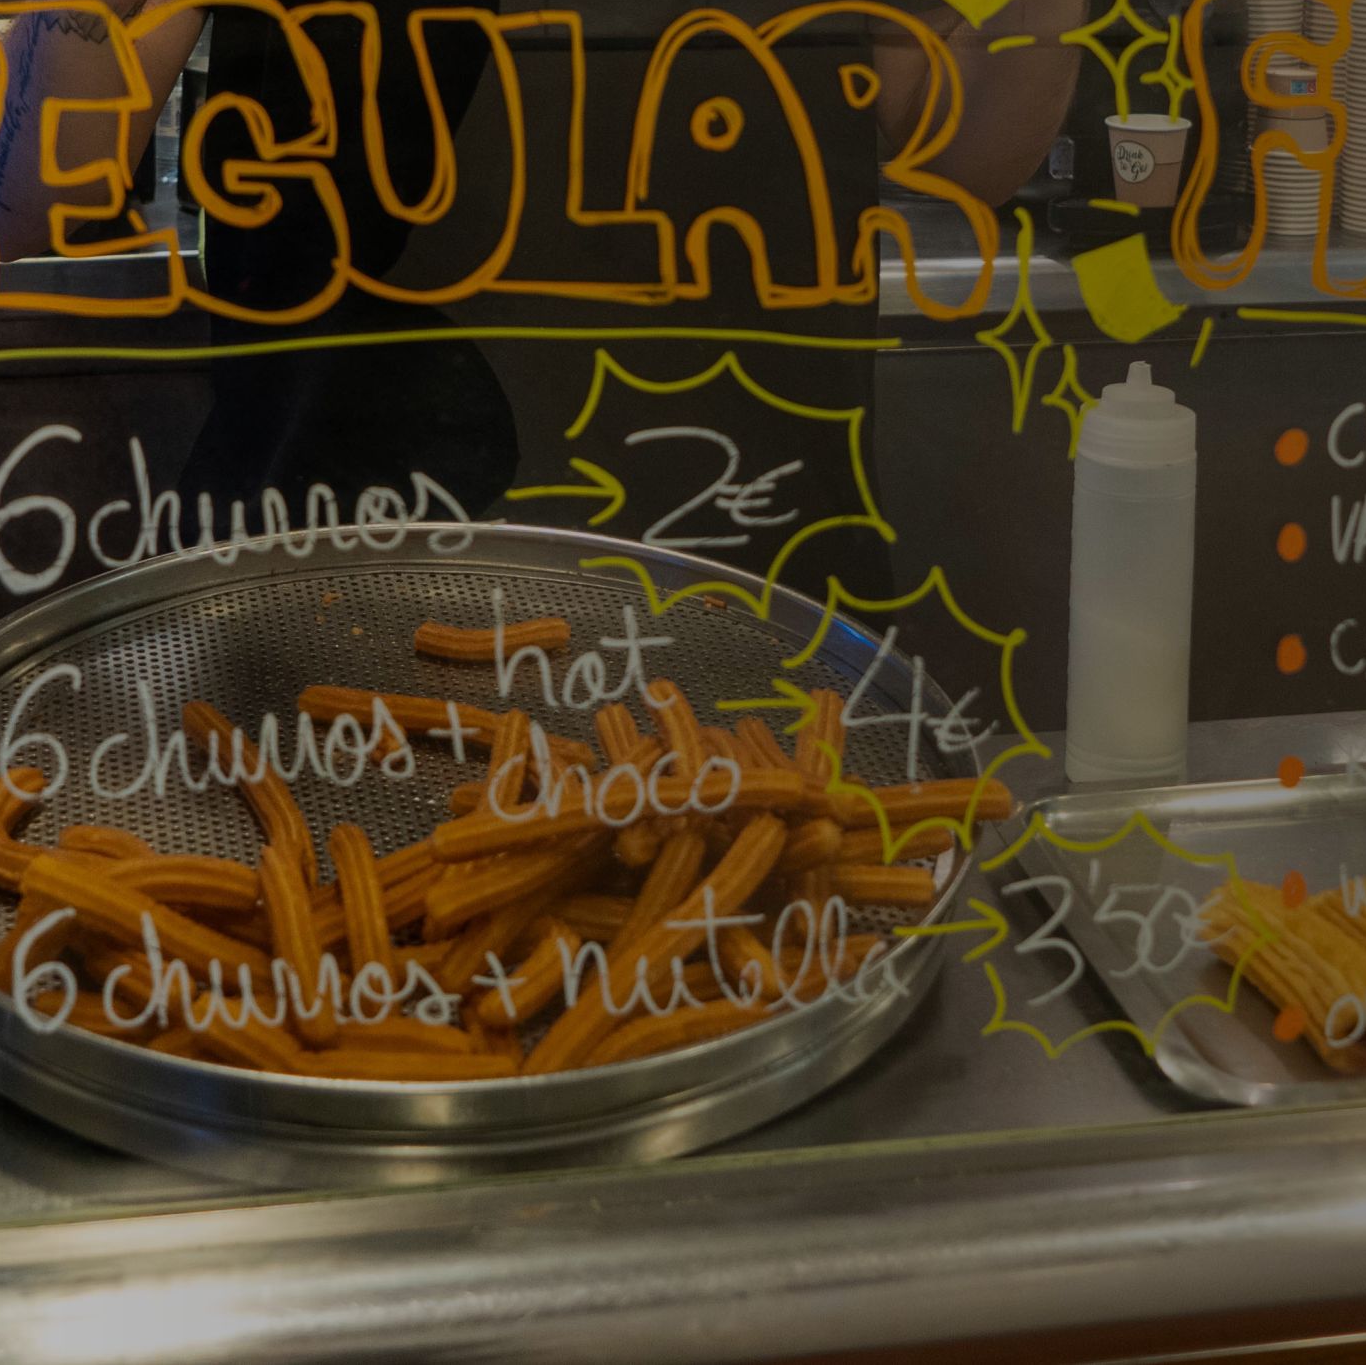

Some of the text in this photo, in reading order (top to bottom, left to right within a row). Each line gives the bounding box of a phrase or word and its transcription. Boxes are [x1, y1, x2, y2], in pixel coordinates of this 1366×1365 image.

[625, 426, 803, 549] 2€
[492, 589, 676, 710] hot
[841, 626, 1002, 792] 4€
[488, 720, 741, 827] choco
[557, 885, 912, 1020] nutella
